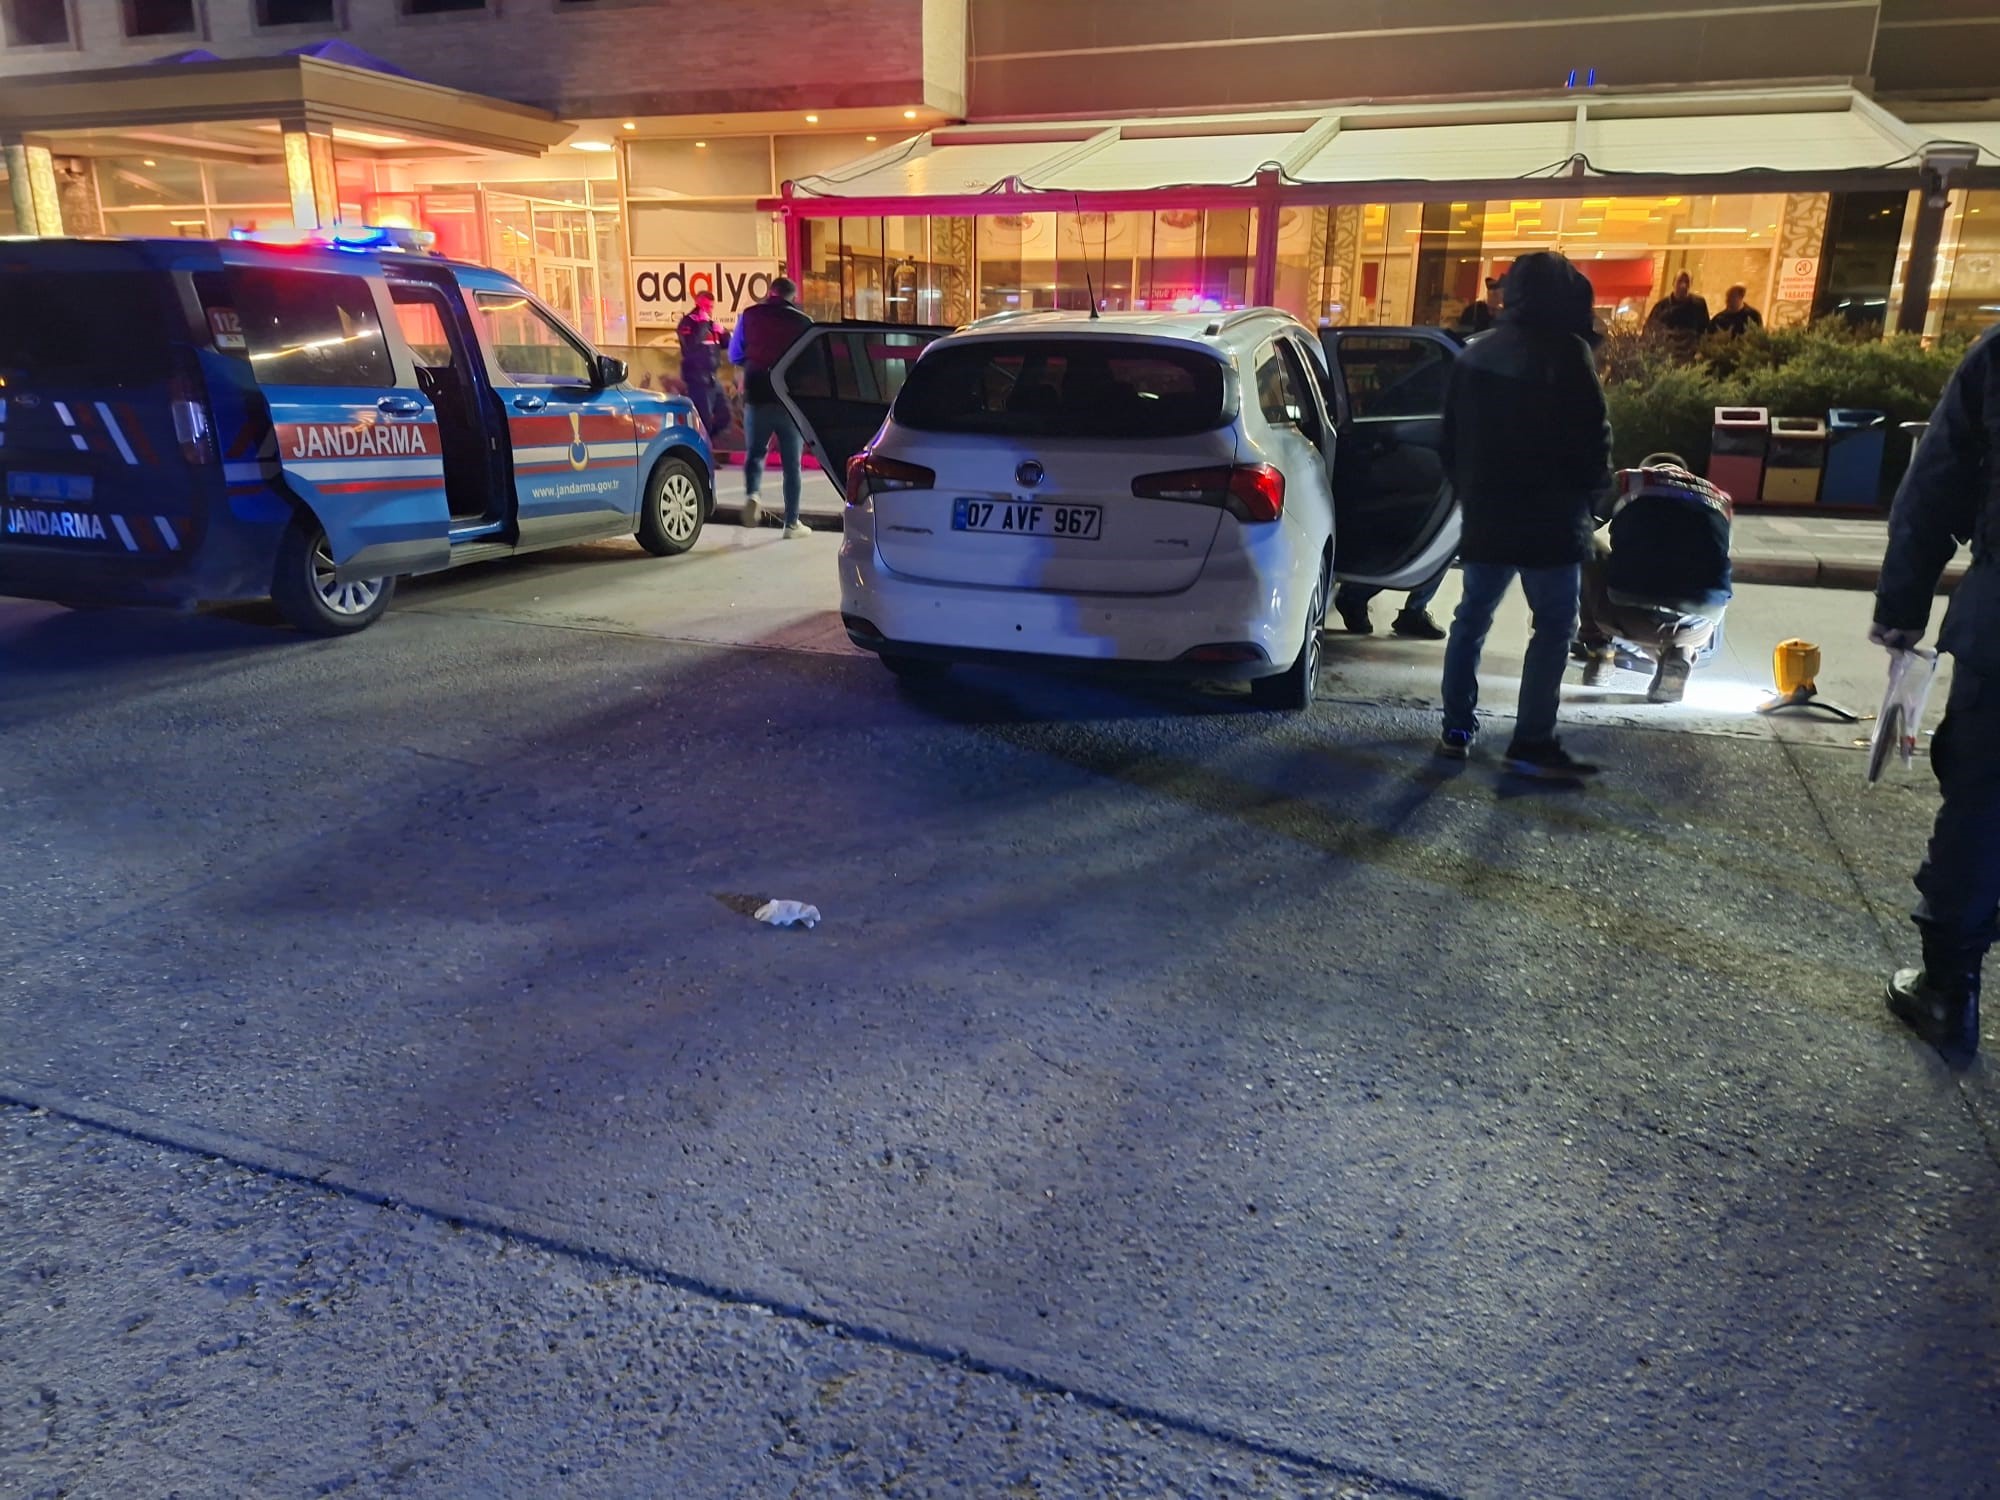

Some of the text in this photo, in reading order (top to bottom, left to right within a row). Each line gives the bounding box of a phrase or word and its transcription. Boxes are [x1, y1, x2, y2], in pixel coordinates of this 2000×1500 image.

[637, 263, 772, 312] adalya
[213, 312, 242, 332] 112
[292, 425, 427, 458] JANDARMA
[532, 479, 619, 499] www.jandarma.gov.tr
[7, 507, 106, 540] JANDARMA
[967, 503, 1097, 535] 07 AVF 967
